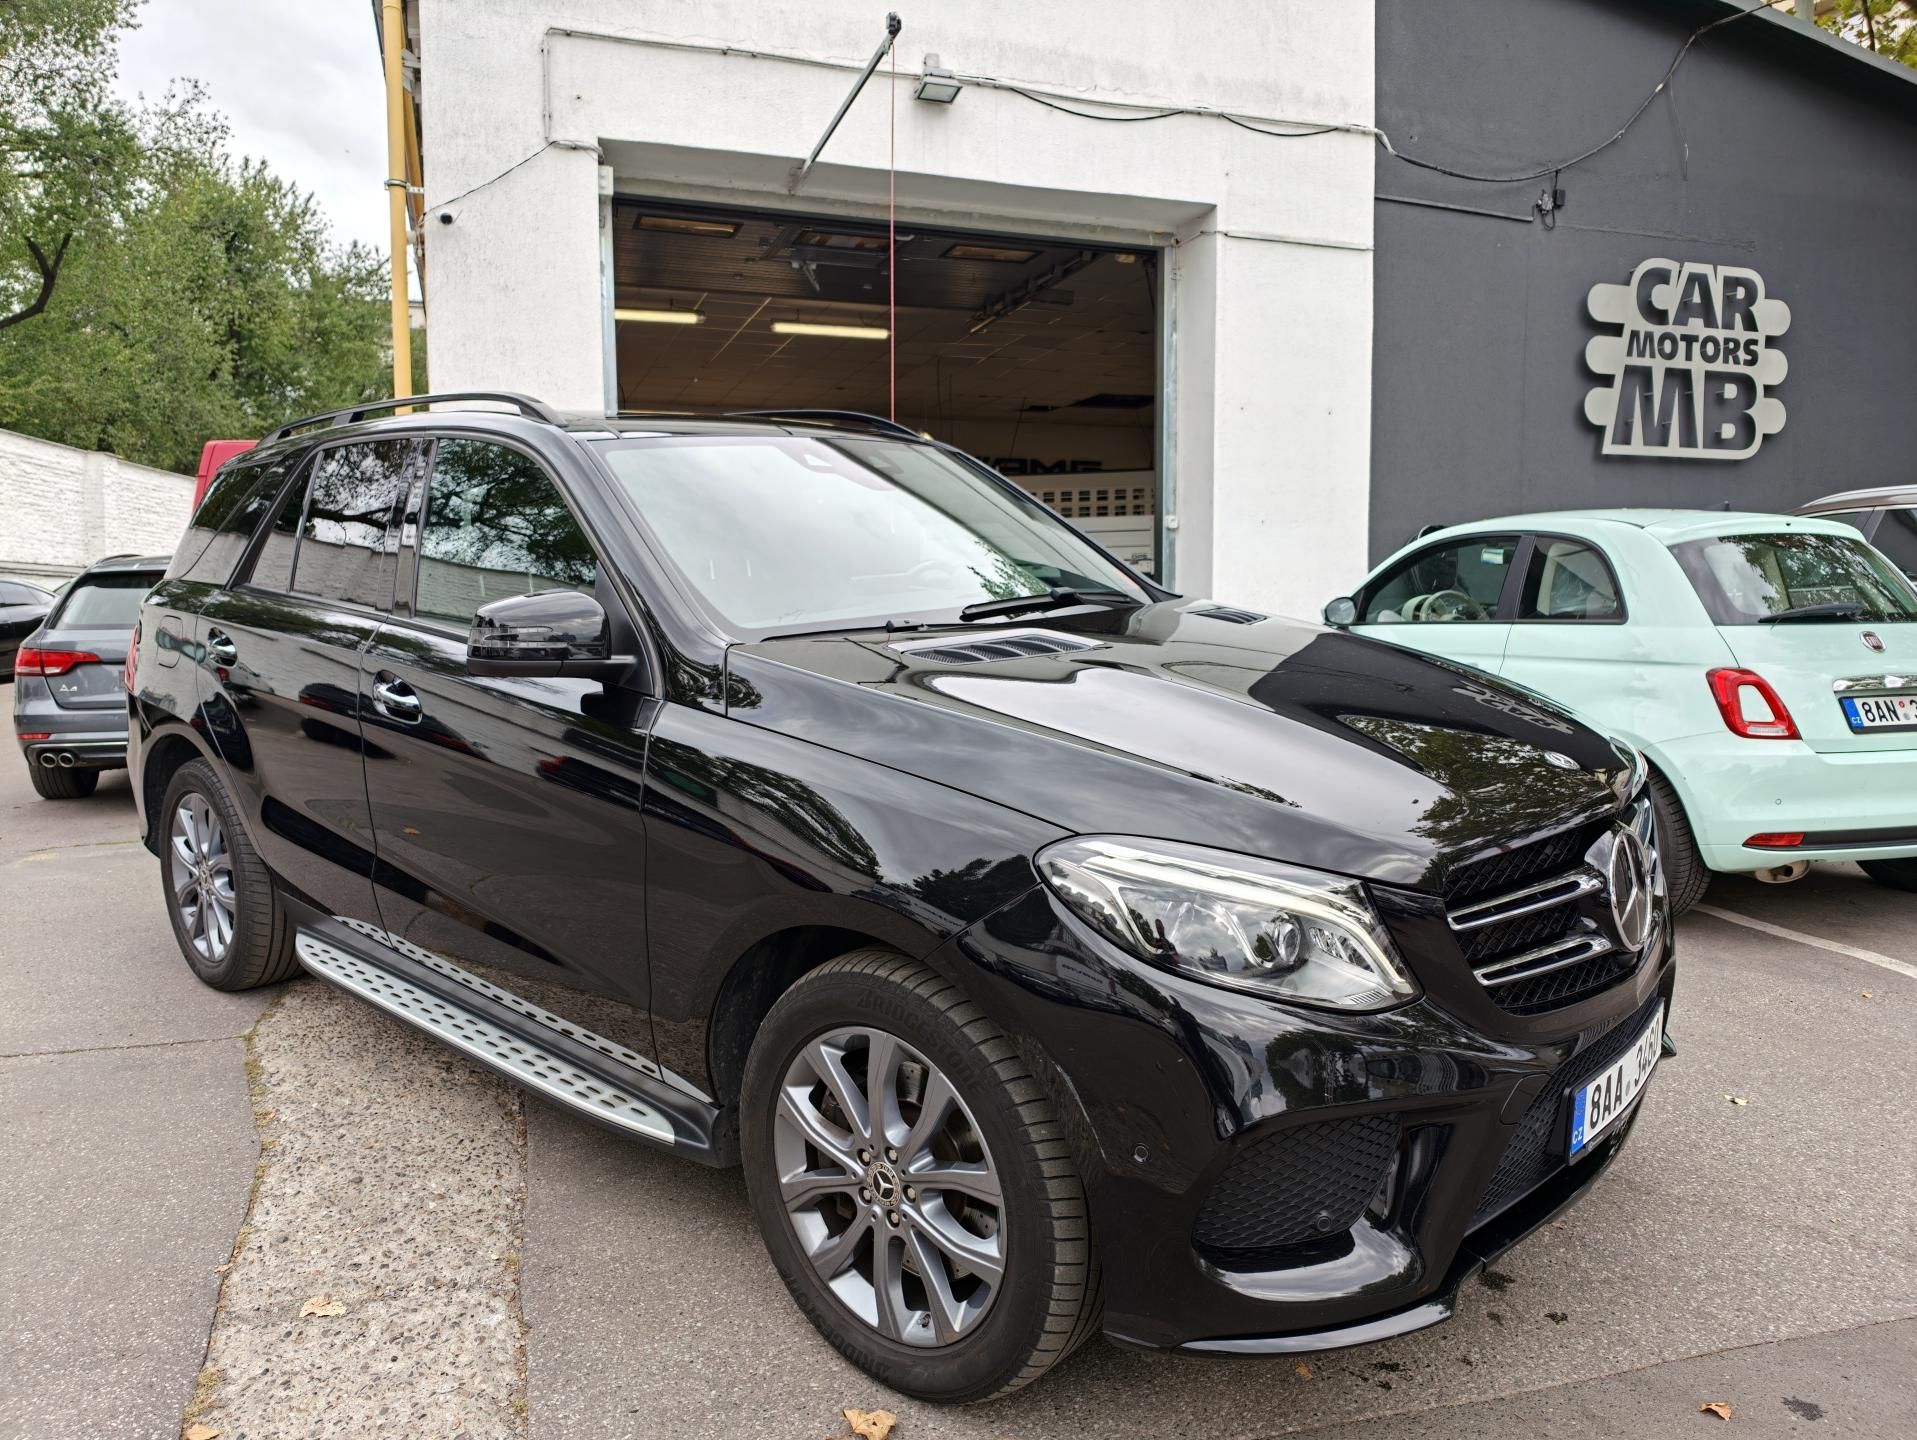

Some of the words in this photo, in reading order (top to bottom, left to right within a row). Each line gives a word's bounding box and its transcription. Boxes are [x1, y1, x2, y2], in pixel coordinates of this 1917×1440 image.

[1636, 266, 1759, 333] CAR
[1626, 329, 1759, 367] MOTORS
[1611, 364, 1758, 451] MB
[1861, 699, 1901, 723] 8AN
[1590, 1064, 1623, 1130] 8AA
[1573, 1125, 1584, 1145] CZ
